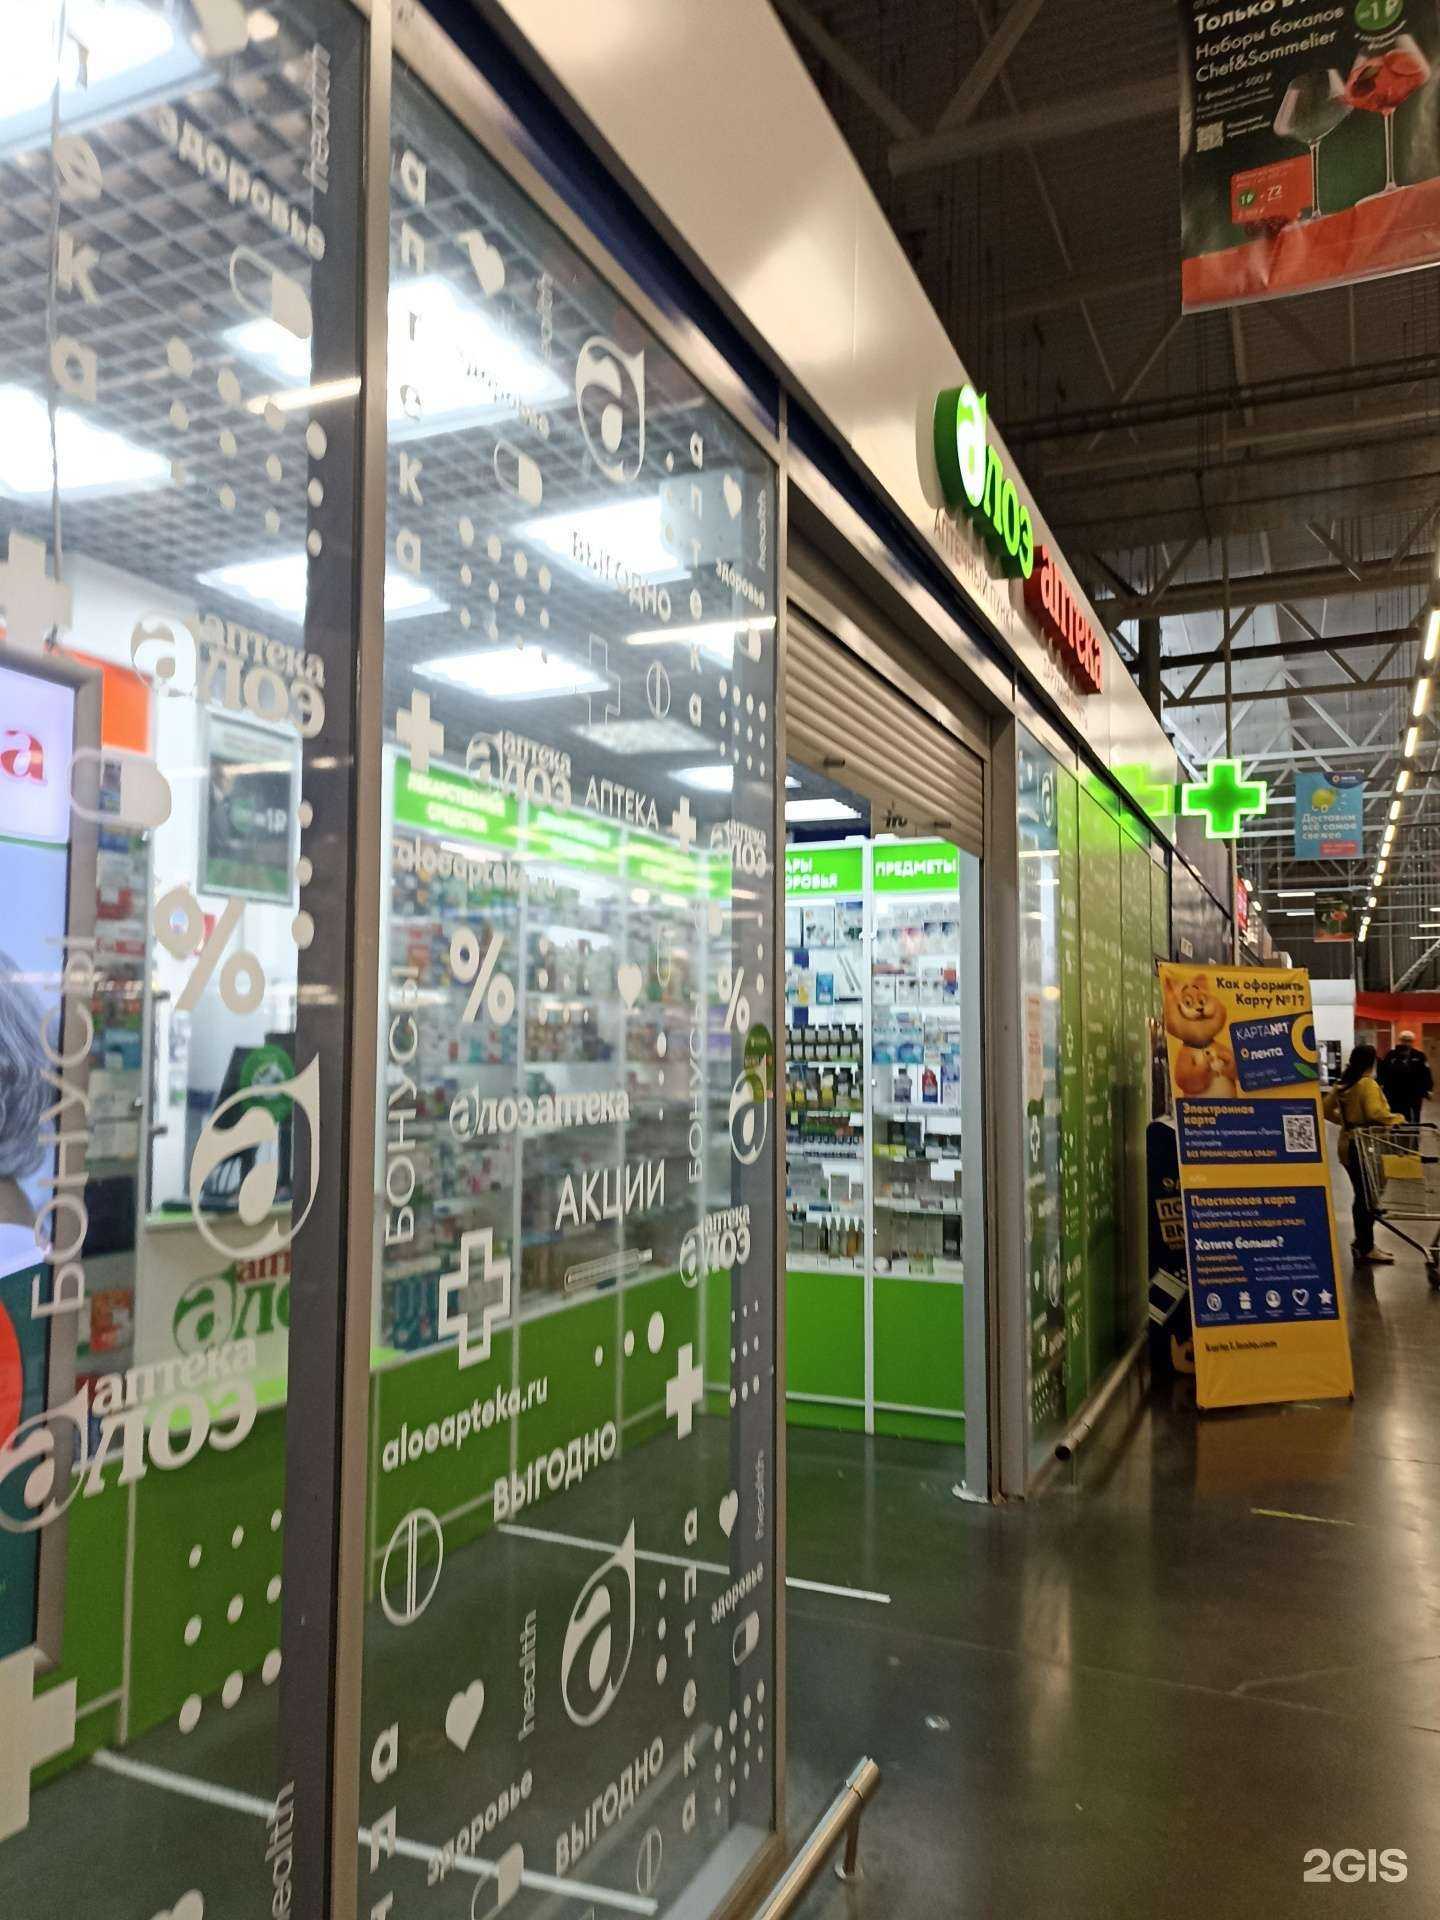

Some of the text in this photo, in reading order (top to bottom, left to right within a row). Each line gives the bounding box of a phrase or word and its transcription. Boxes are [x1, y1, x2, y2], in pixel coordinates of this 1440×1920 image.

[1194, 0, 1275, 34] Только
[1196, 27, 1267, 60] Наборы
[1270, 7, 1344, 37] бокалов
[584, 775, 660, 832] АПТЕКА
[875, 858, 956, 877] ПРЕДМЕТЫ
[1216, 977, 1304, 993] Как оформить
[1235, 993, 1272, 1009] Карту
[554, 1159, 666, 1231] АКЦИИ
[92, 1338, 257, 1417] аптека
[493, 1421, 617, 1523] ВЫГОДНО
[518, 1609, 537, 1742] health
[556, 1736, 664, 1877] ВЫГОДНО
